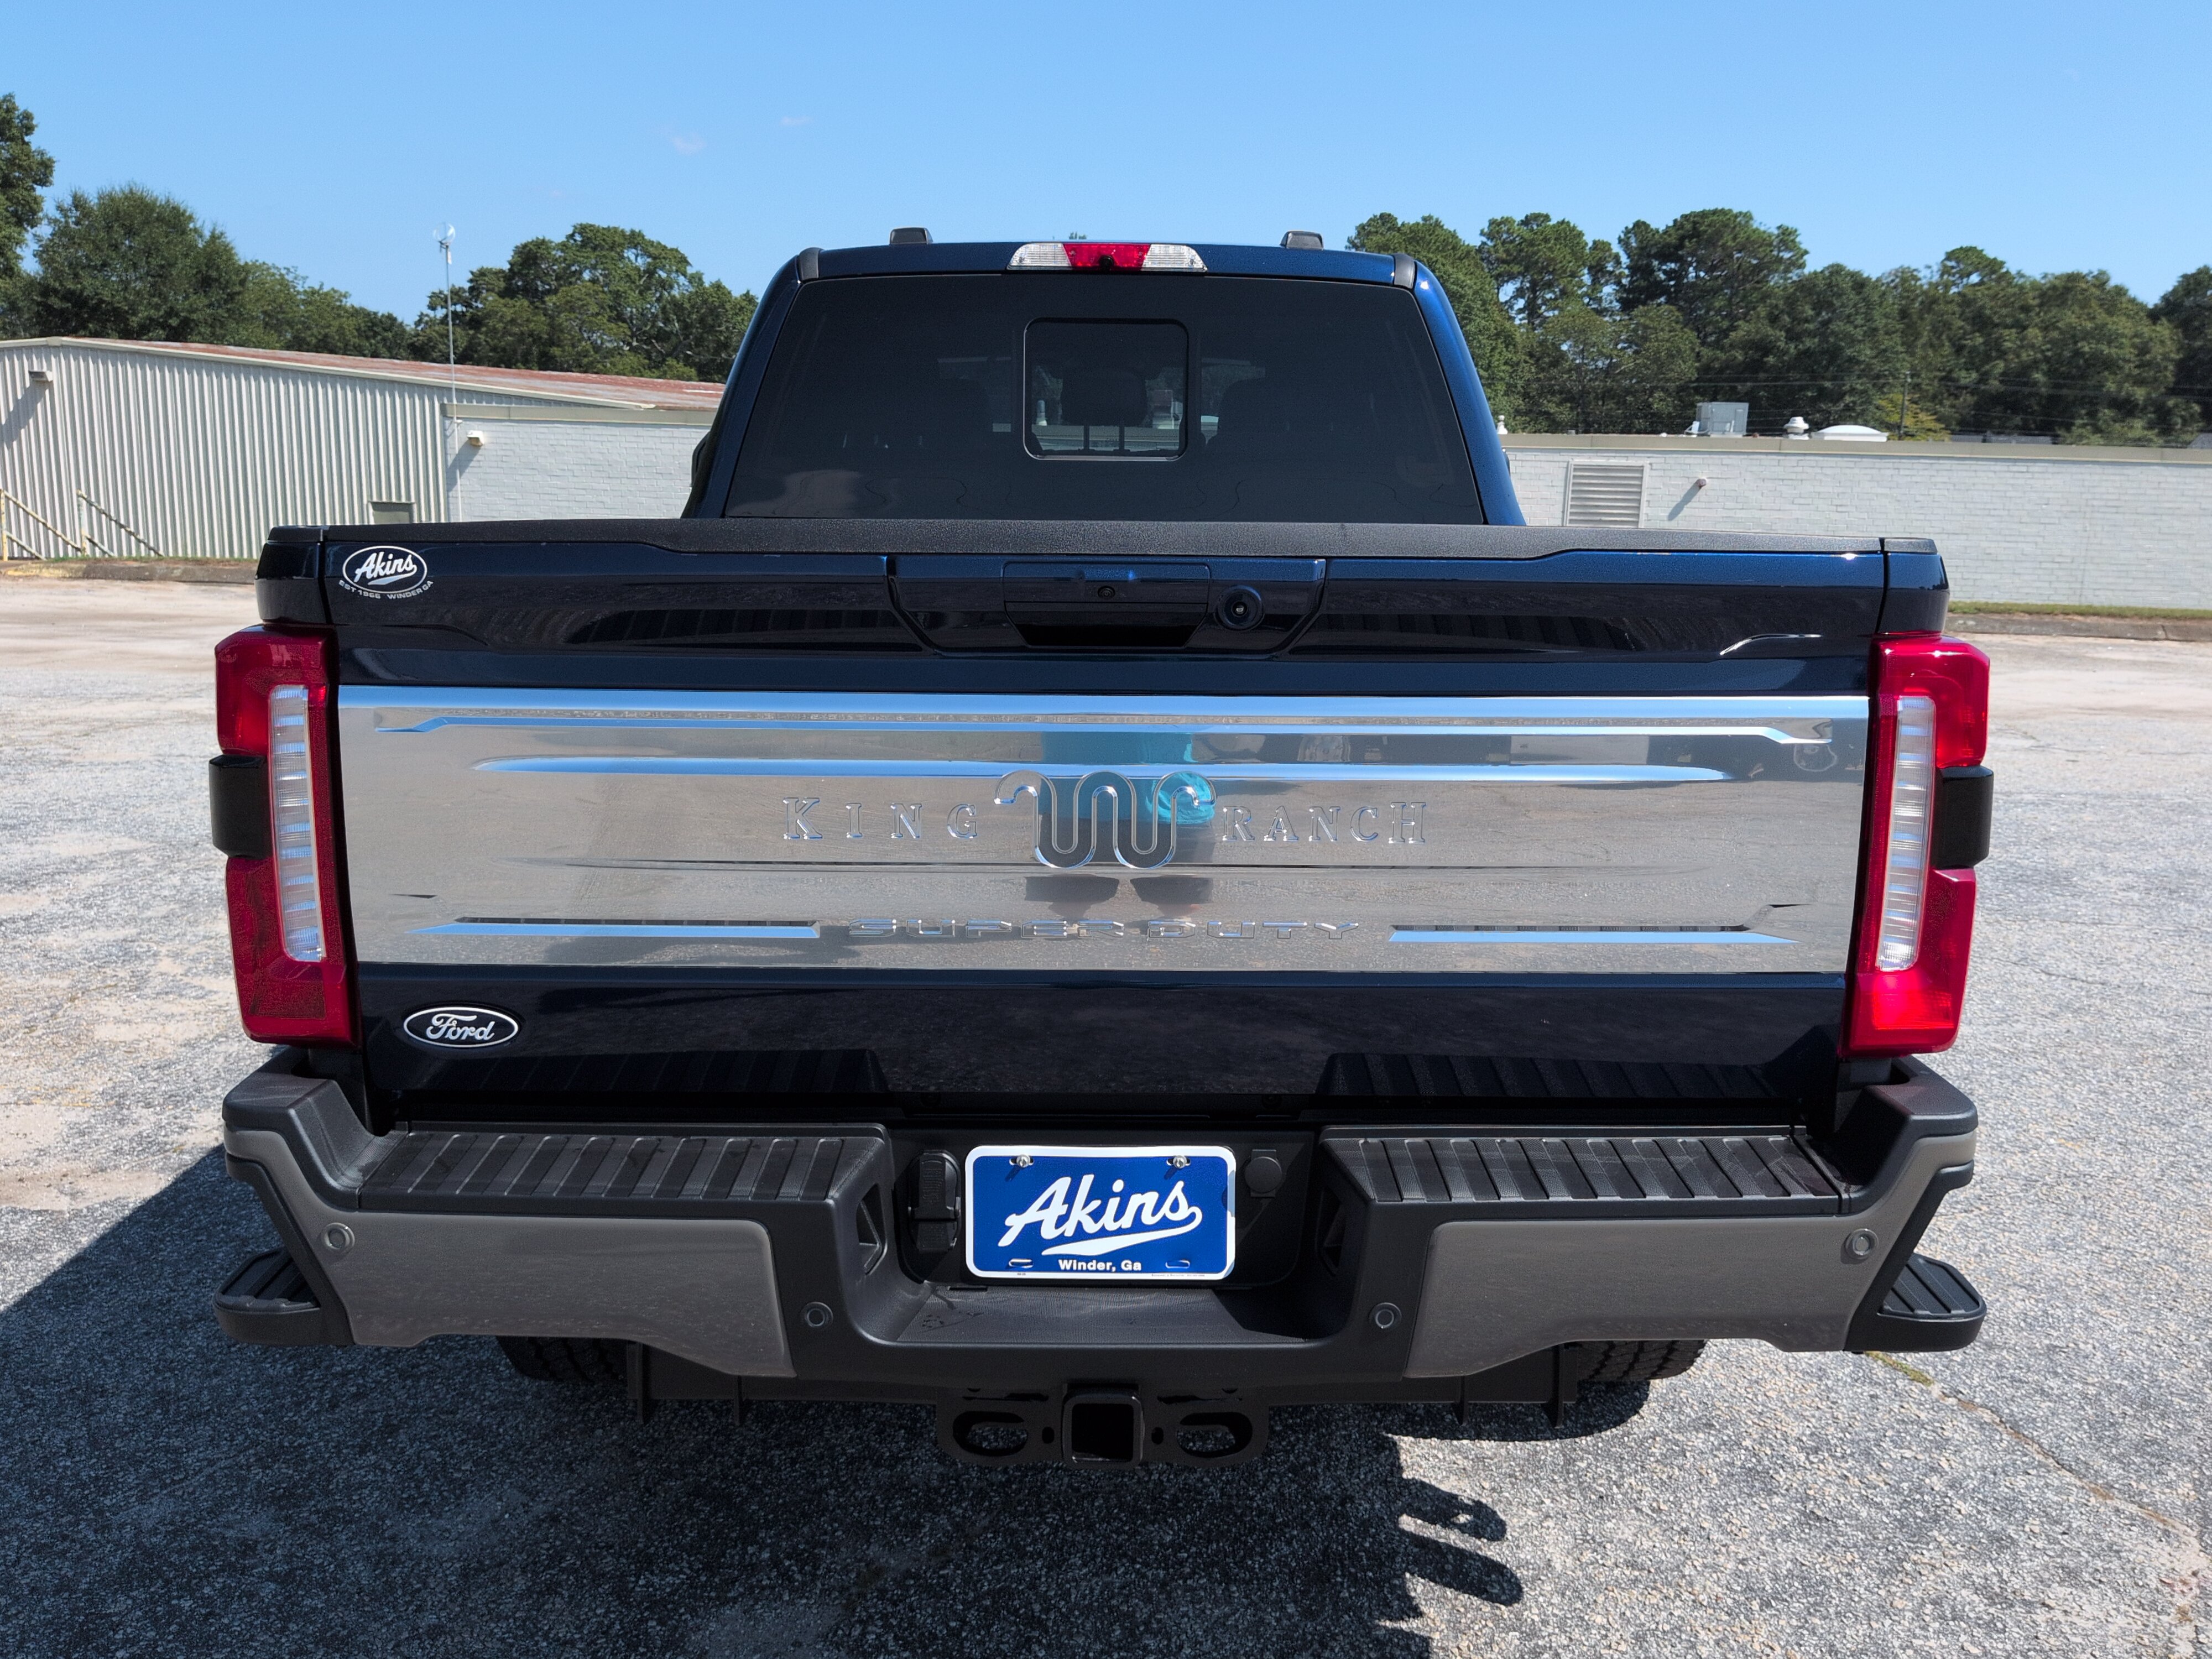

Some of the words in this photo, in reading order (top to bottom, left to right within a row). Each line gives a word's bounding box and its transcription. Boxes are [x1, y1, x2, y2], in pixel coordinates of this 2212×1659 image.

[353, 552, 418, 583] Akins
[338, 580, 357, 592] EST
[357, 589, 381, 599] 1966
[387, 588, 423, 599] WINDER
[422, 581, 434, 591] GA
[783, 797, 978, 839] KING
[1222, 801, 1427, 844] RANCH
[849, 919, 1124, 938] SUPER
[1147, 920, 1359, 940] DUTY
[426, 1013, 495, 1040] Ford
[998, 1173, 1202, 1248] Akins
[1058, 1259, 1116, 1272] Winder,
[1120, 1259, 1142, 1272] Ga
